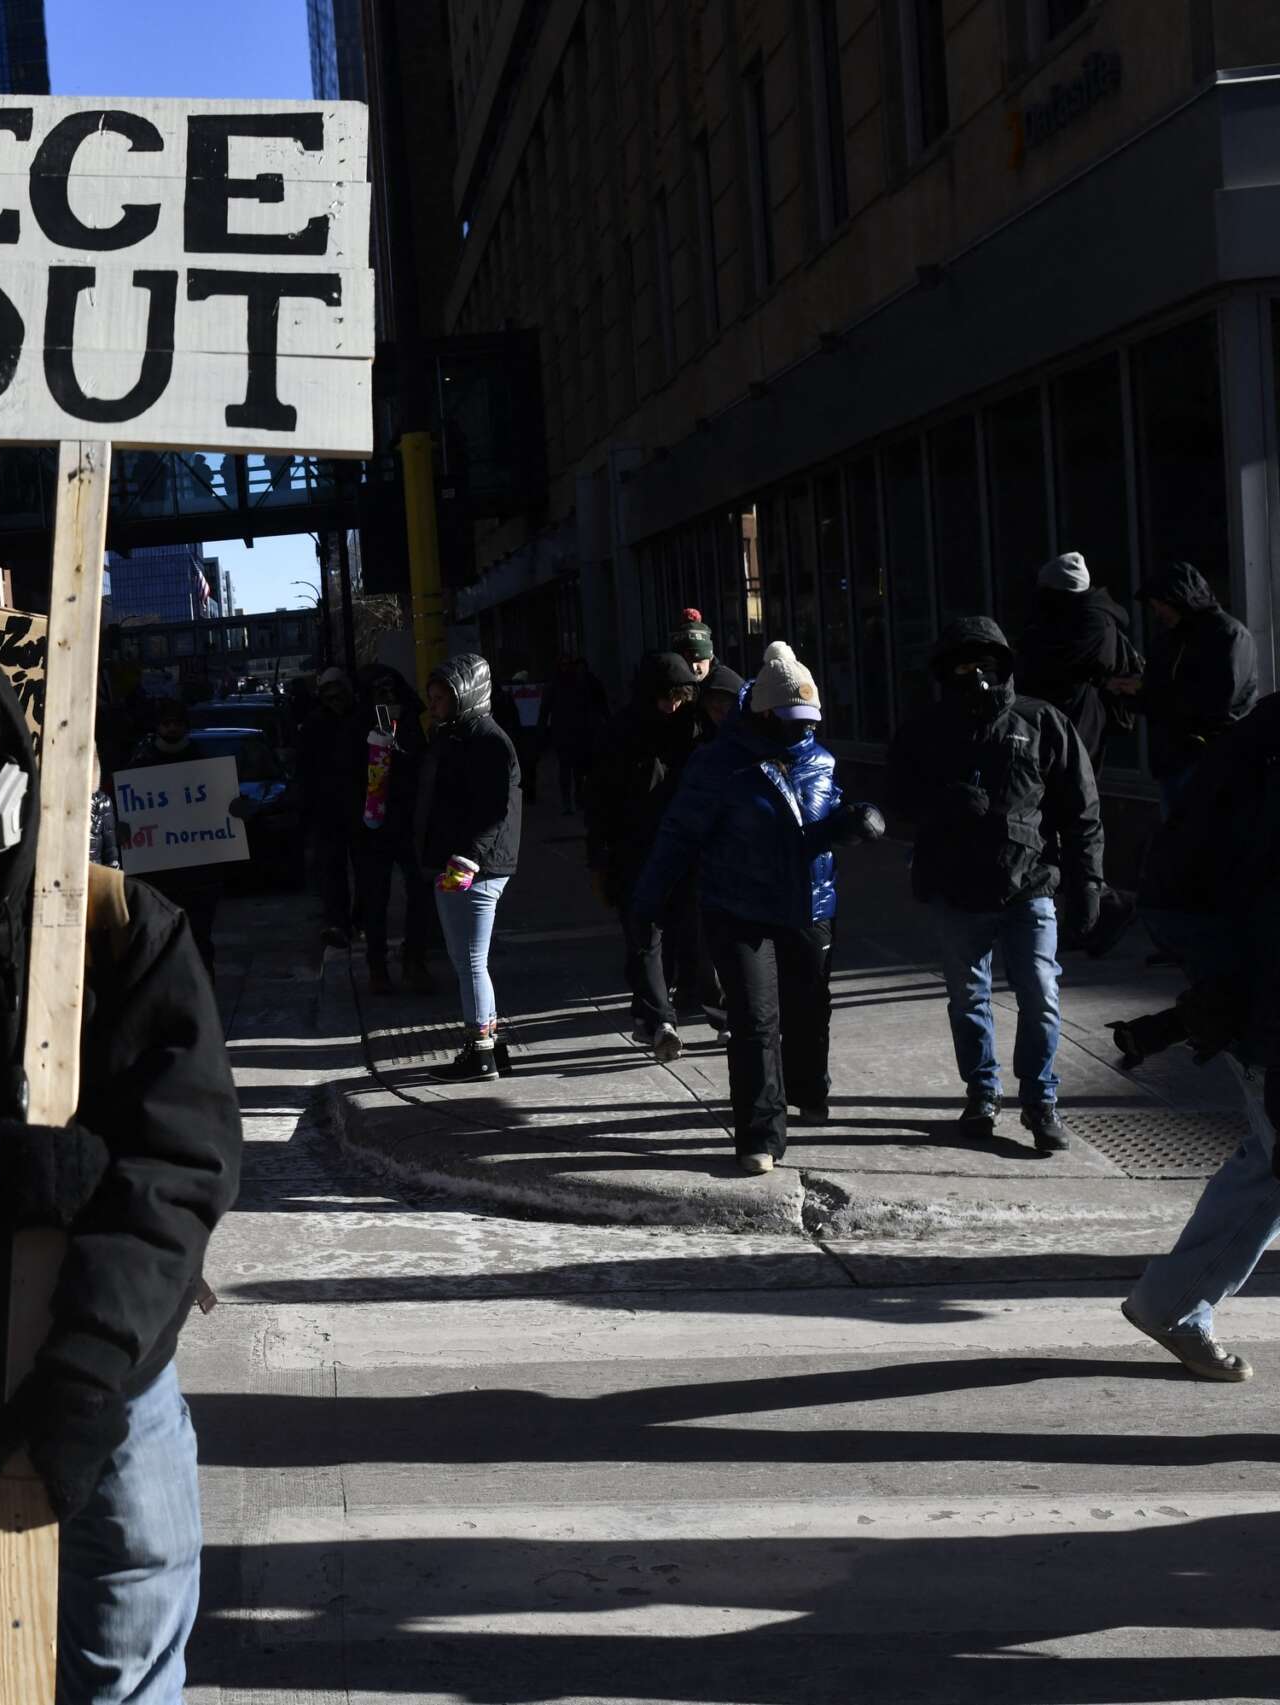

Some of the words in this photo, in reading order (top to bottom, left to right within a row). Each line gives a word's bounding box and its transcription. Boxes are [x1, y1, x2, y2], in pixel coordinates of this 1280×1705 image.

[117, 784, 168, 812] This
[184, 784, 207, 805] is
[166, 817, 236, 845] normal
